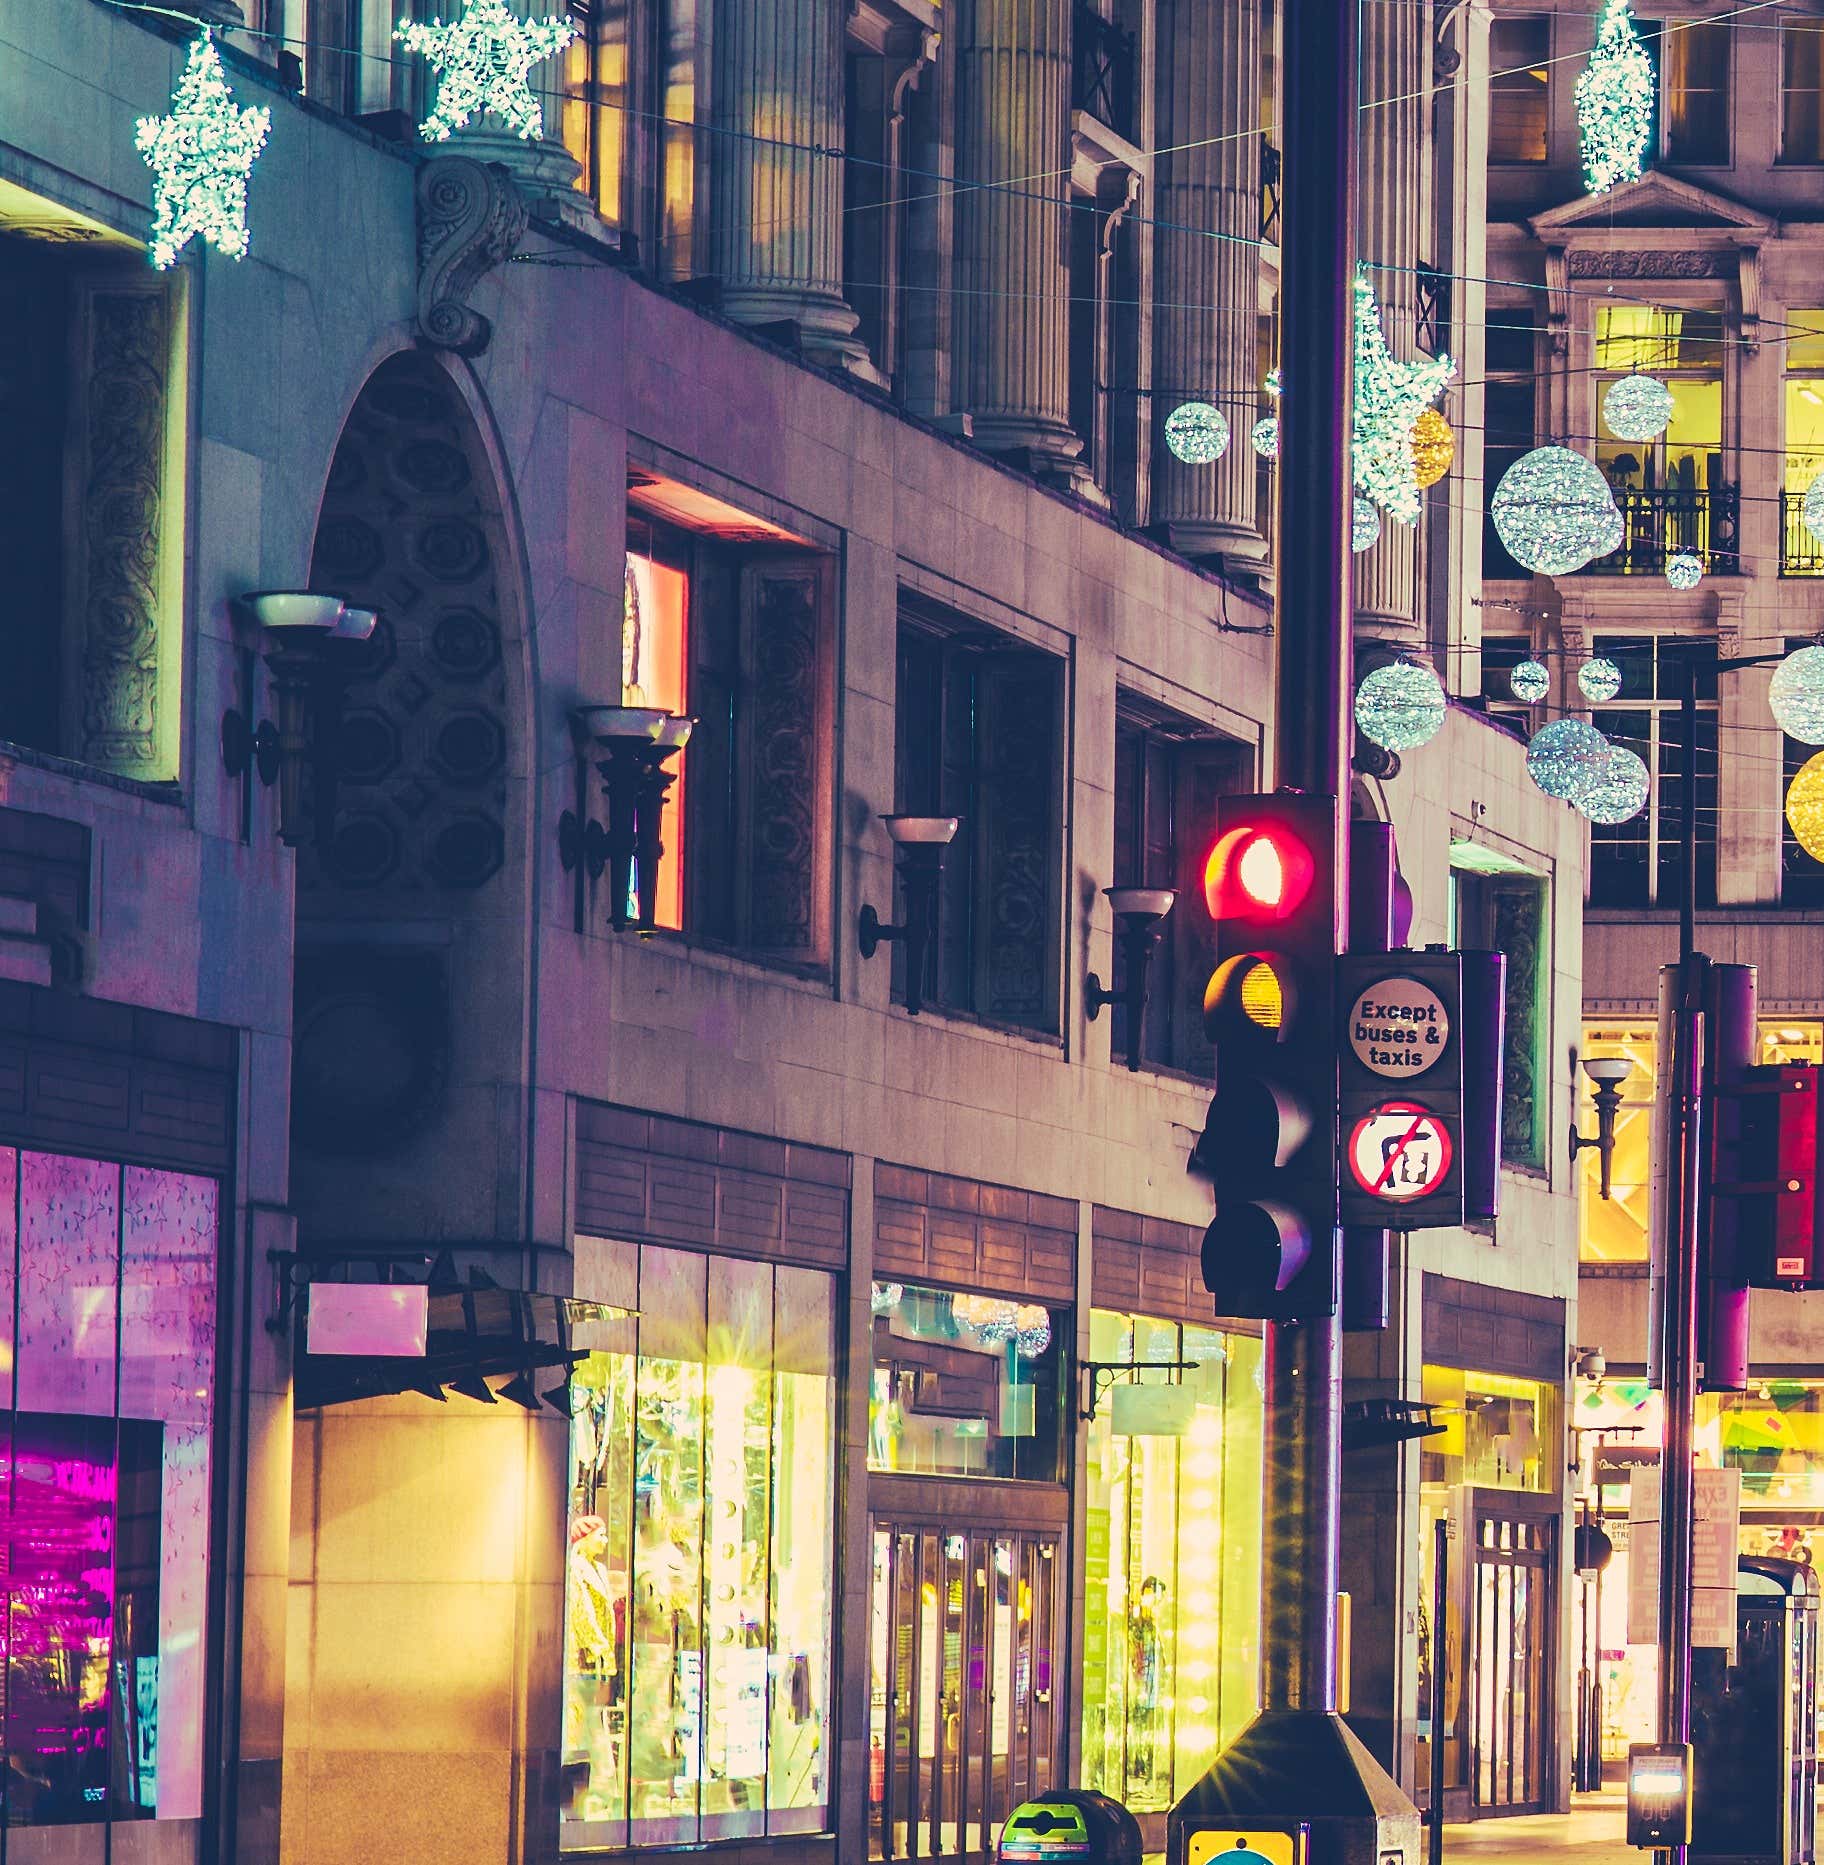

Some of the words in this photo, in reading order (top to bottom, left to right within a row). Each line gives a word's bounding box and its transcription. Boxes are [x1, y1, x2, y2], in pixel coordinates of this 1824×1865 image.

[1361, 1001, 1437, 1023] Except
[1355, 1022, 1418, 1043] buses
[1425, 1026, 1440, 1044] &
[1369, 1046, 1423, 1067] taxis
